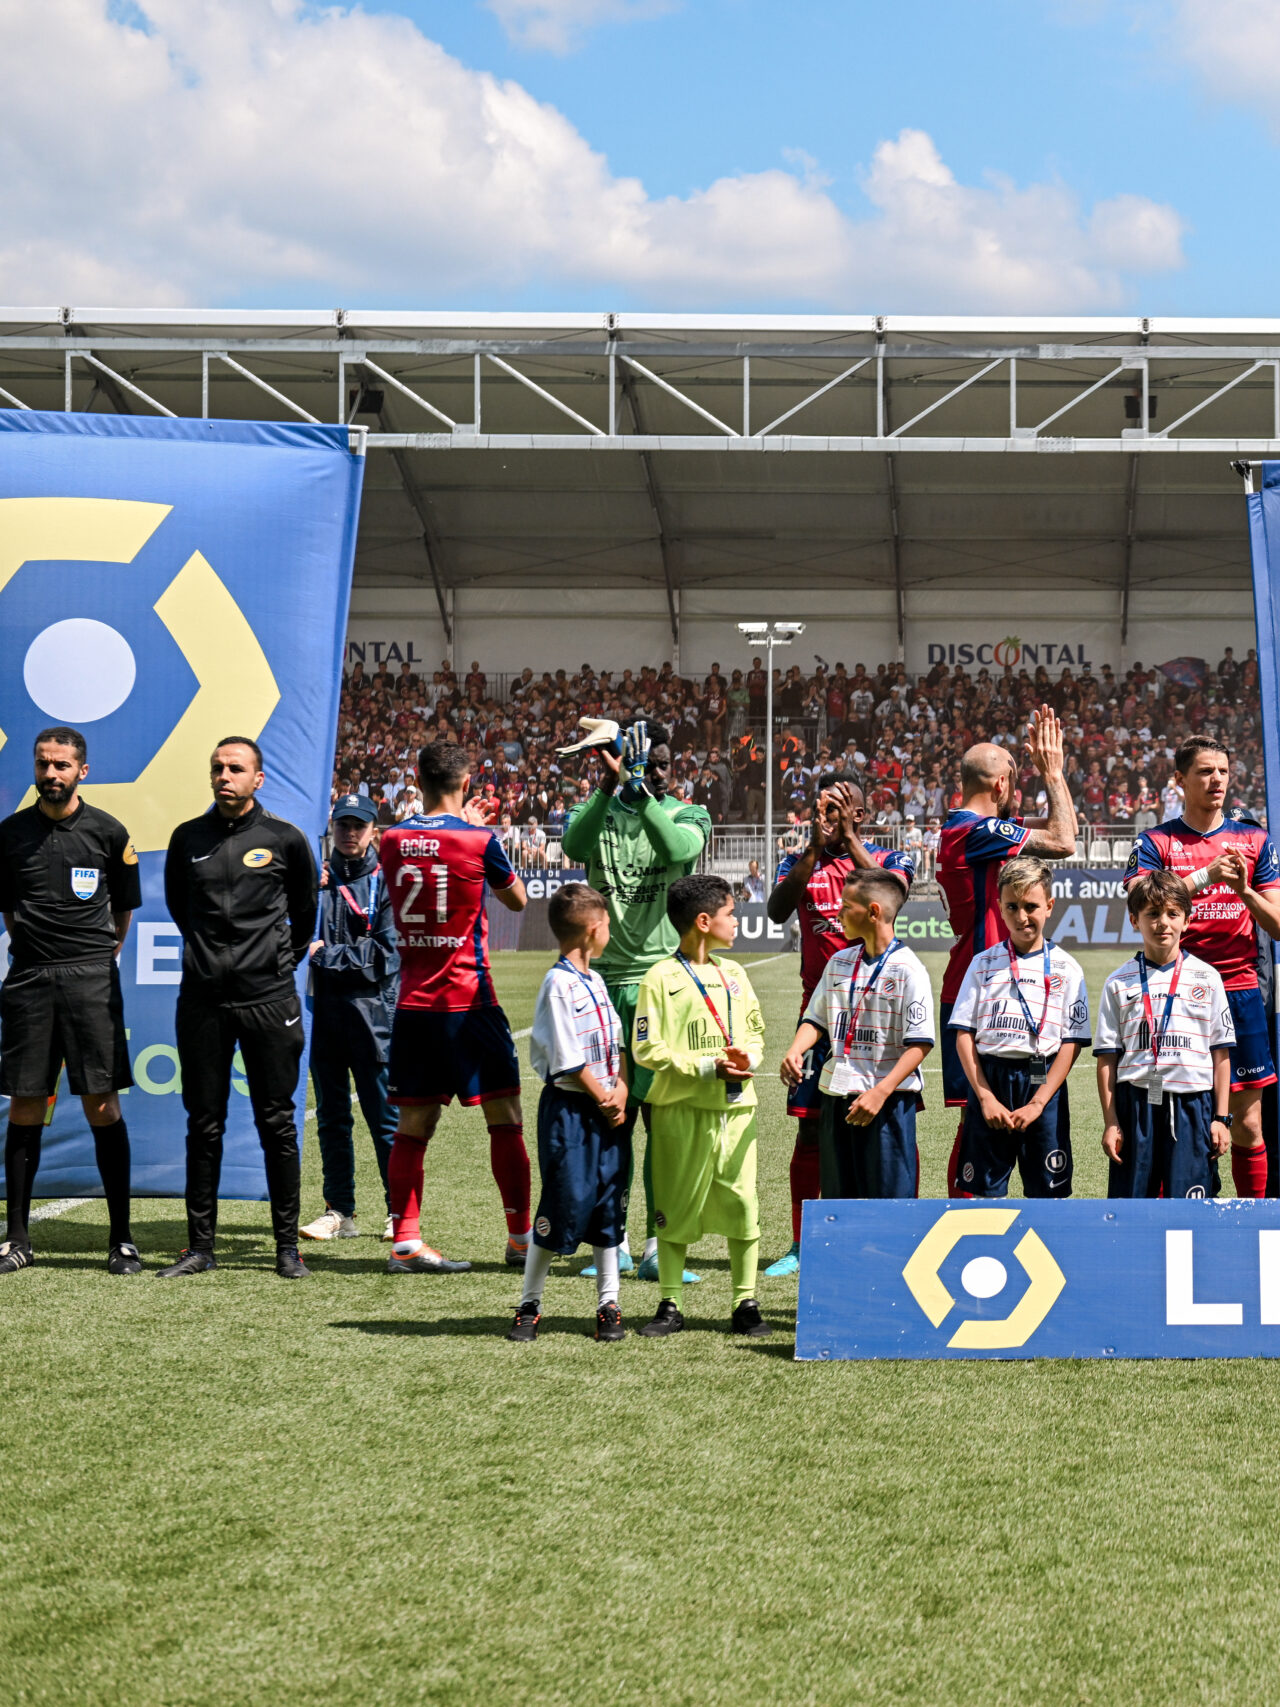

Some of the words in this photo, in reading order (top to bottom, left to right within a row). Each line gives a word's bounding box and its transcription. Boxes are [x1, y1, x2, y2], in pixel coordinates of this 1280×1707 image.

[344, 641, 423, 663] NTAL
[928, 640, 1092, 667] DISCONTAL
[75, 870, 95, 878] FIFA
[548, 870, 560, 878] DE
[395, 864, 448, 923] 21
[1079, 881, 1129, 899] auve
[1049, 904, 1145, 943] ALL
[1198, 911, 1240, 919] FERRAND
[894, 916, 955, 938] Eats
[909, 1007, 922, 1019] NG
[1073, 1007, 1085, 1019] NG
